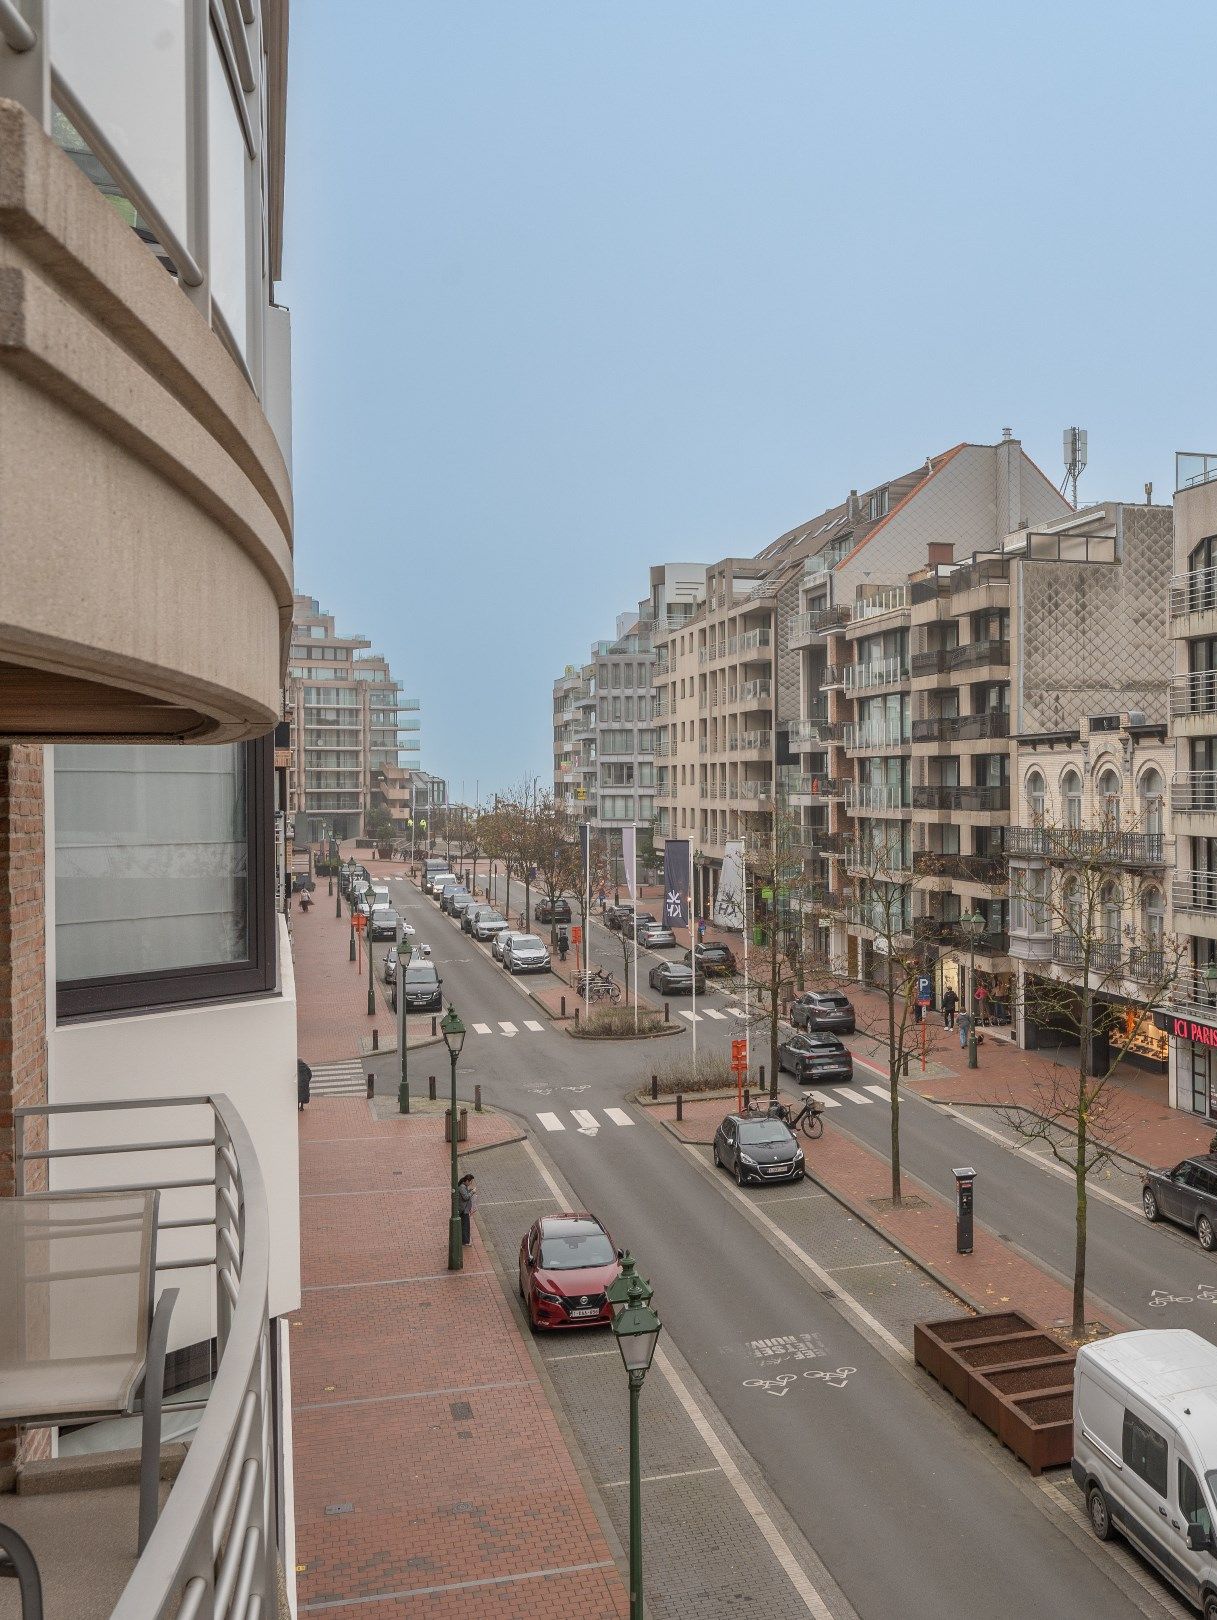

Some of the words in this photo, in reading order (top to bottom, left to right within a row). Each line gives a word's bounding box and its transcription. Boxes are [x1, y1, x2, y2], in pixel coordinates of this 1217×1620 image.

[919, 978, 929, 992] P
[1173, 1018, 1188, 1040] ICI
[1191, 1023, 1217, 1047] PARIS
